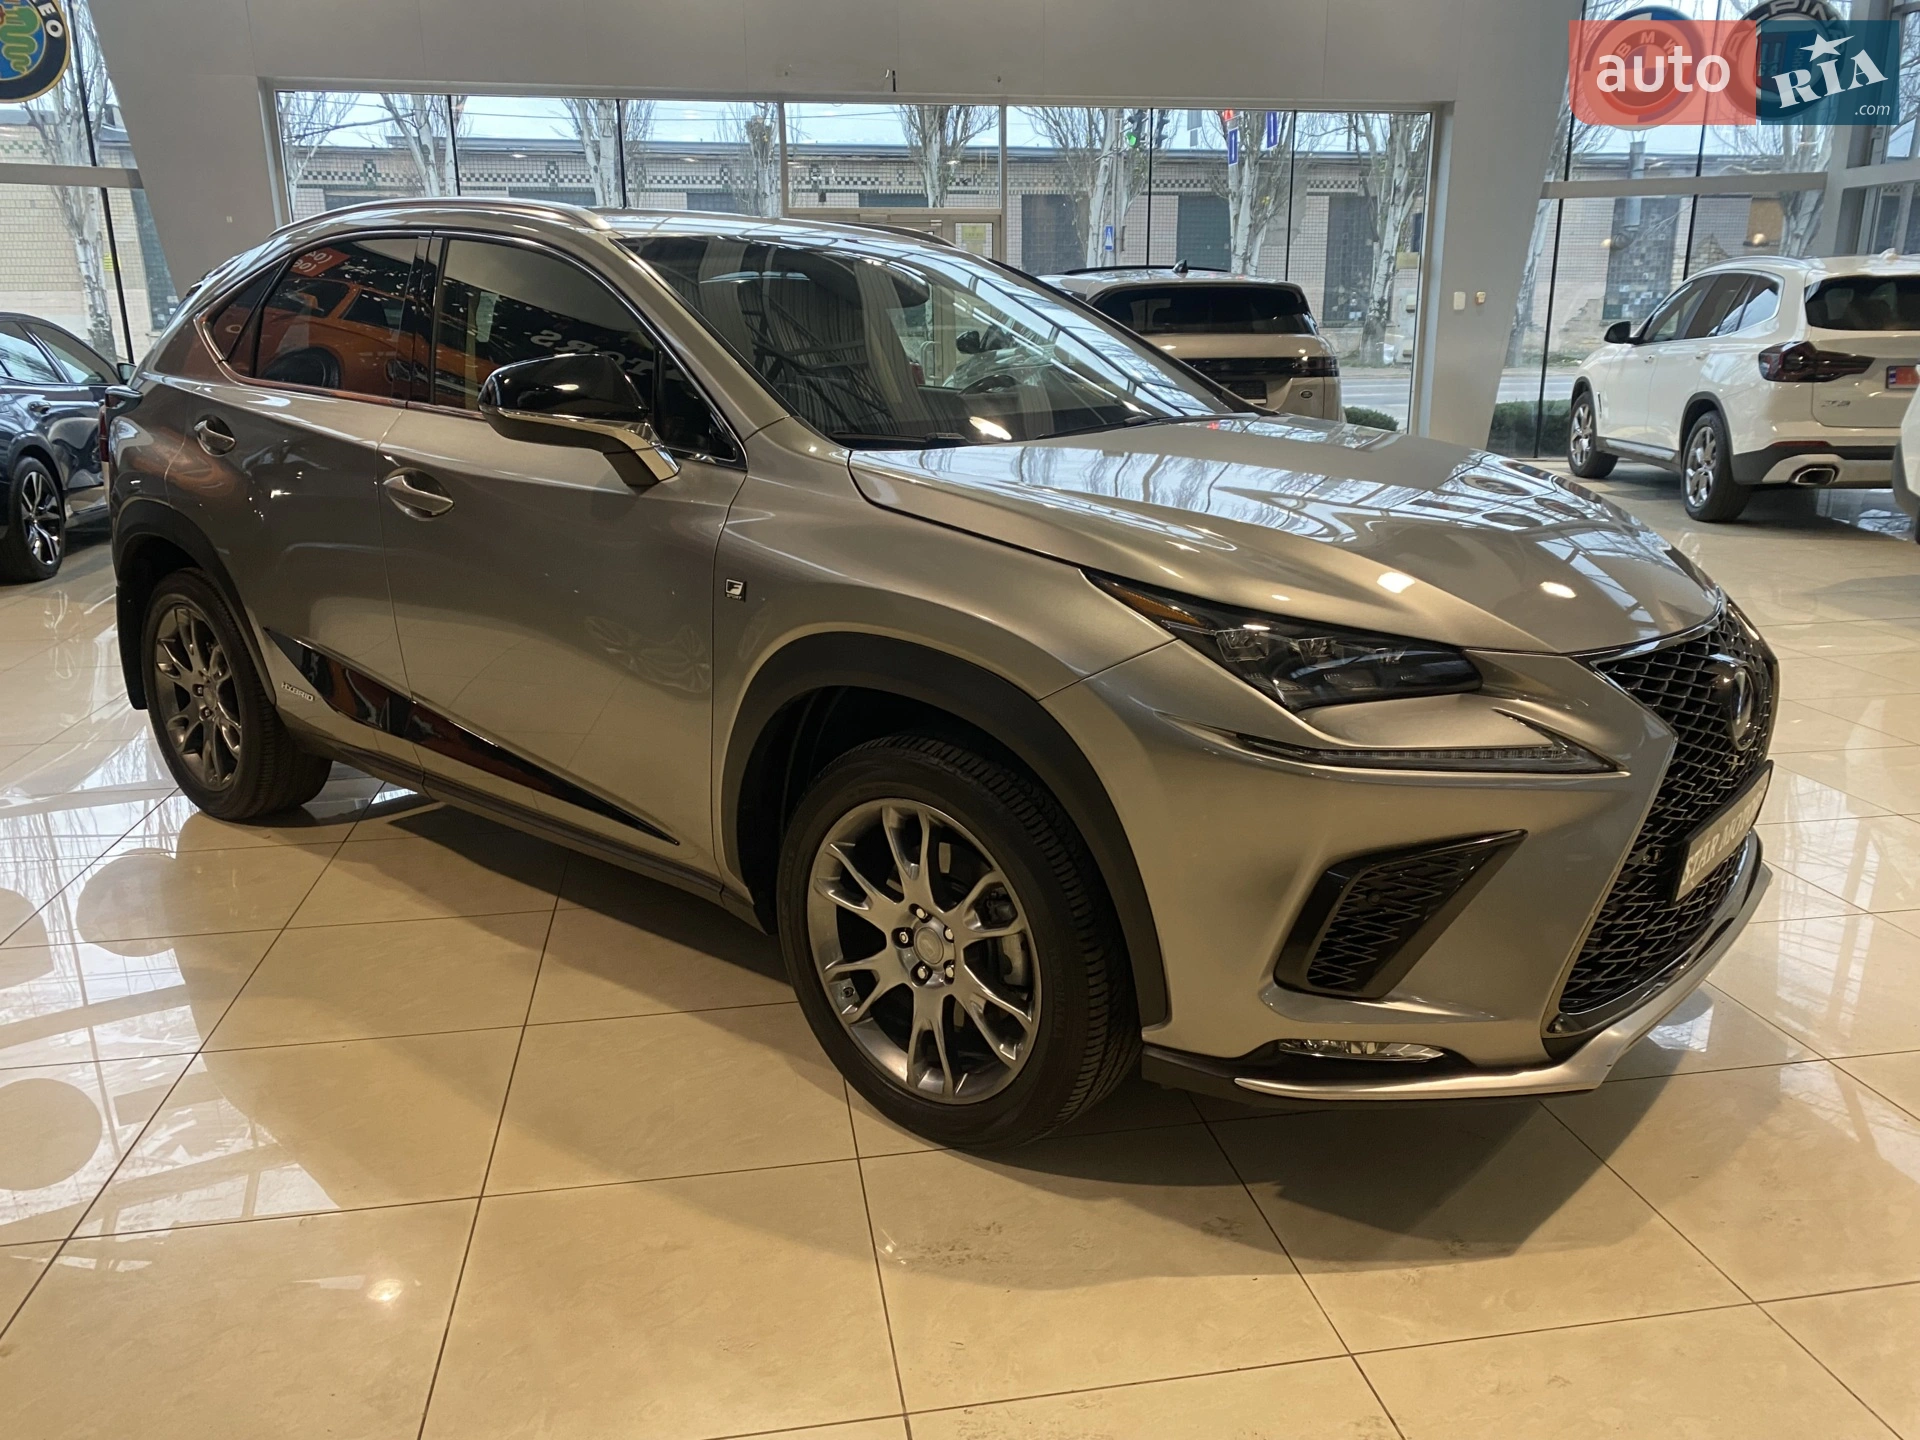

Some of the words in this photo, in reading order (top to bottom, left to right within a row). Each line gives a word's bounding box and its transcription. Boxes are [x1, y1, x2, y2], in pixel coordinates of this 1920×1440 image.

[32, 0, 63, 37] EO
[1617, 31, 1680, 58] BMW
[281, 681, 315, 702] HYBRID
